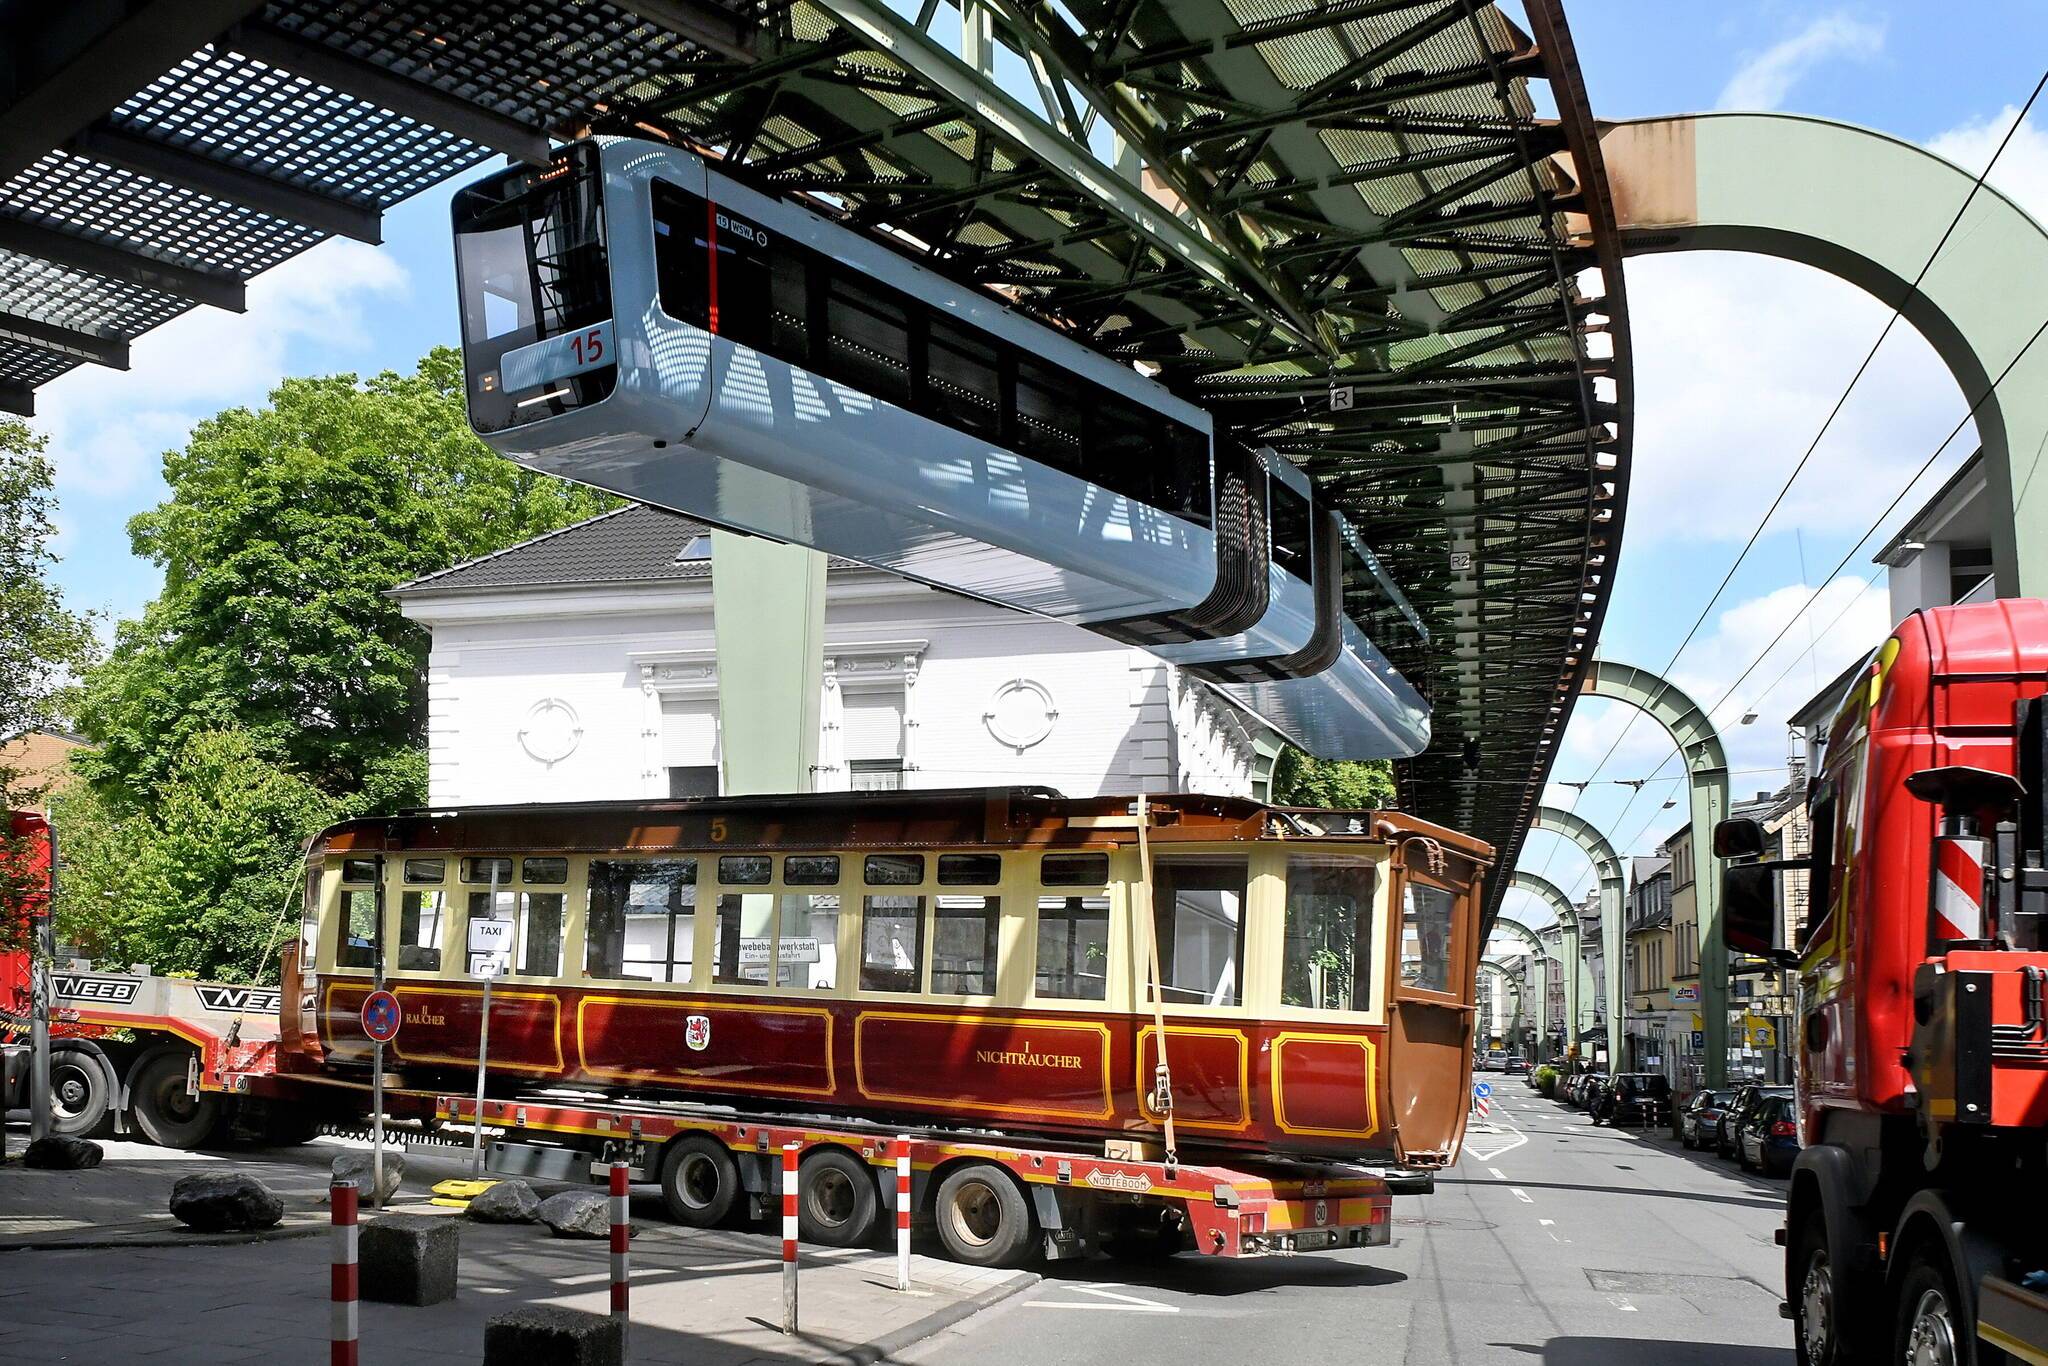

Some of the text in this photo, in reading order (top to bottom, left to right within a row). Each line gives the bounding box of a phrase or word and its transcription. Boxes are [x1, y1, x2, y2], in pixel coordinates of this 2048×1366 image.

[719, 215, 752, 239] 15 WSW
[571, 330, 603, 365] 15
[1335, 391, 1348, 407] R
[1452, 555, 1468, 567] R2
[711, 818, 727, 842] 5
[480, 926, 502, 936] TAXI
[739, 941, 815, 951] webebawerkstatt
[62, 978, 130, 998] NEEB
[1677, 987, 1693, 995] dm
[213, 989, 281, 1009] NEE
[406, 1013, 445, 1026] RAUCHER
[1025, 1041, 1029, 1053] I
[976, 1050, 1082, 1069] NICHTRAUCHER
[236, 1078, 247, 1090] 80
[1093, 1176, 1147, 1189] NOOTEBOOM
[1316, 1204, 1326, 1221] 80
